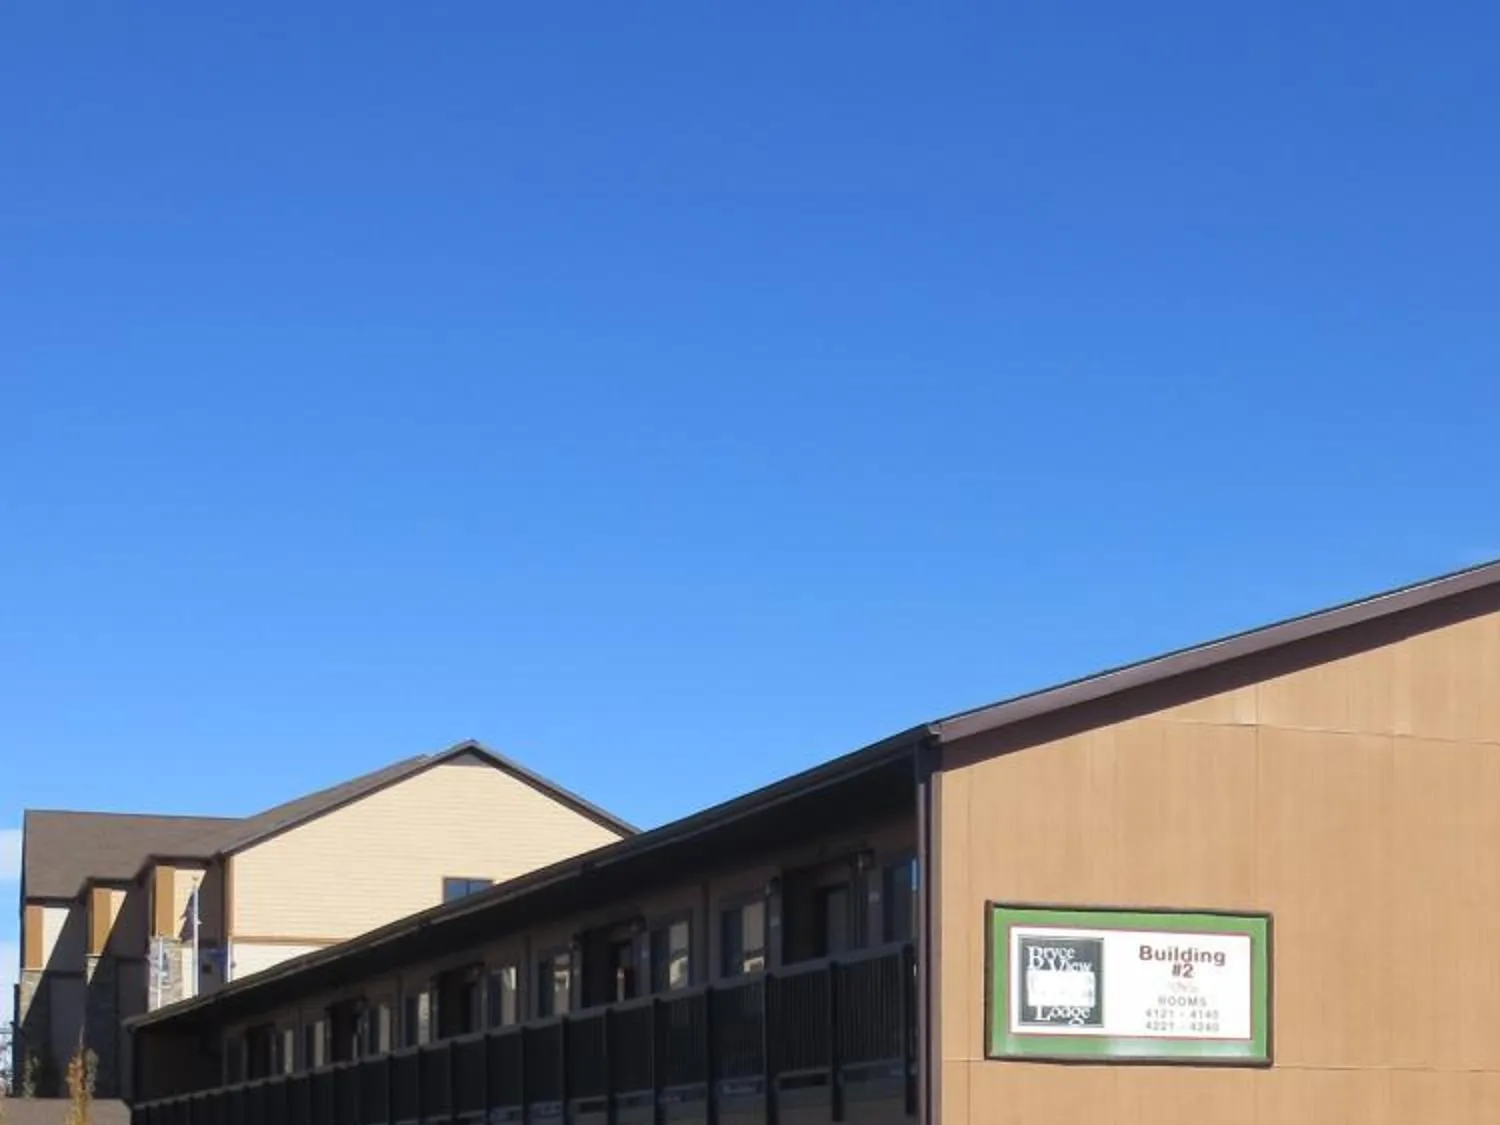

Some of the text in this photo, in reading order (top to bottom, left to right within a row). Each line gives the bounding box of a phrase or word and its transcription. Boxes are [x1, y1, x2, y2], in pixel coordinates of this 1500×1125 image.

[1026, 946, 1076, 970] Bryce
[1138, 945, 1226, 966] Building
[1171, 964, 1194, 978] #2
[1157, 995, 1207, 1007] ROOMS
[1033, 1005, 1091, 1025] Lodge
